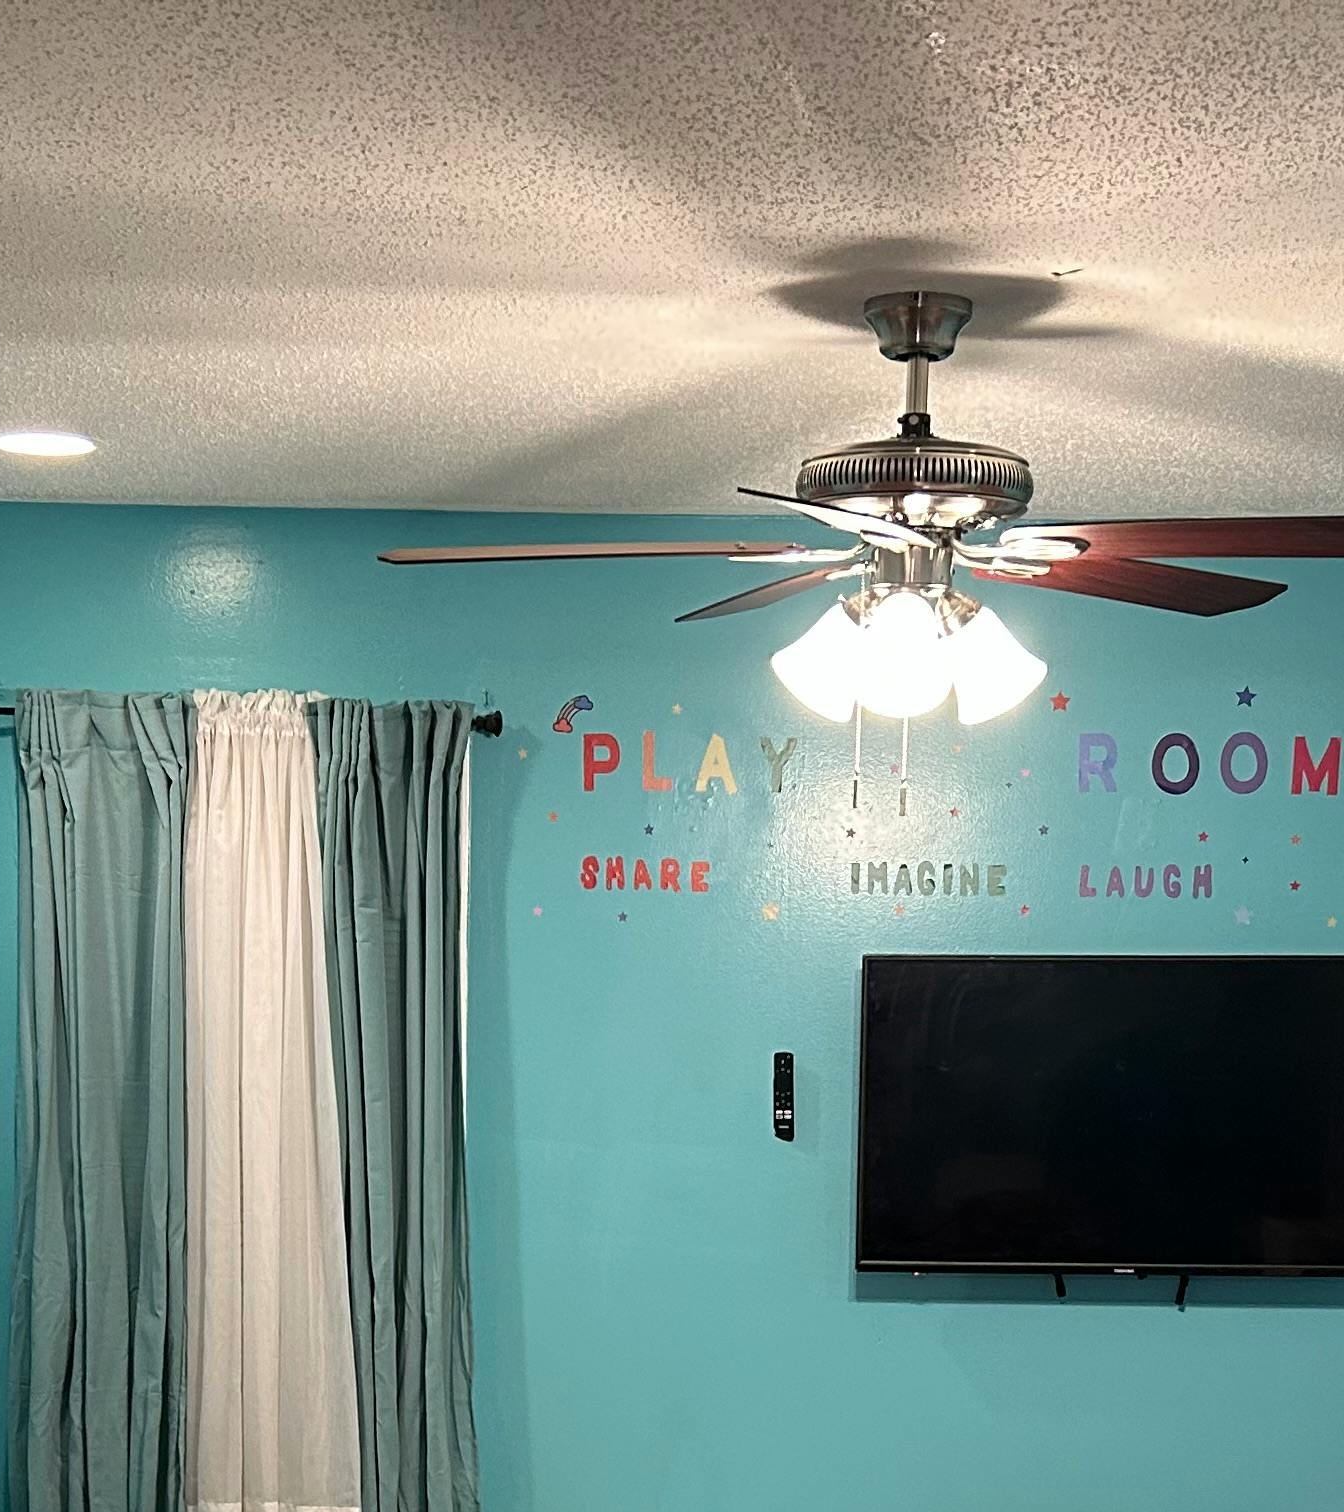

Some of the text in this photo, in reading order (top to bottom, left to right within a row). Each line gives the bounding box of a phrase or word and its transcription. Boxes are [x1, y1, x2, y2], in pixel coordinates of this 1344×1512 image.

[583, 730, 1342, 796] PLAY ROOM
[580, 856, 1213, 899] SHARE IMAGINE LAUGH
